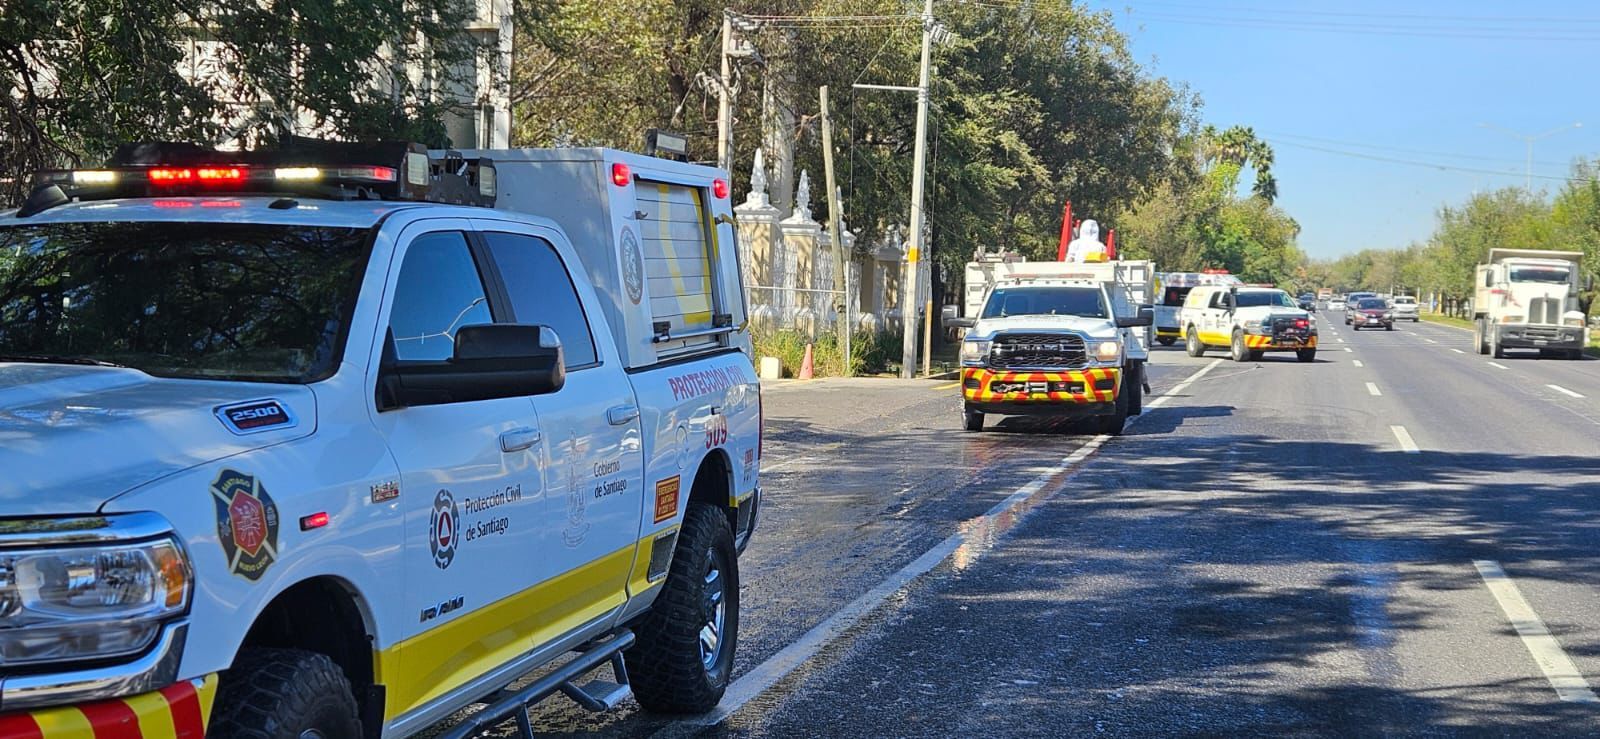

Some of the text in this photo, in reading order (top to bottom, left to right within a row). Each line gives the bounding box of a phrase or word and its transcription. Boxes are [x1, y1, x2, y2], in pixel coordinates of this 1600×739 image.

[231, 406, 279, 420] 2500
[705, 415, 727, 449] 509
[593, 460, 621, 477] Gobierno
[594, 478, 627, 498] de Santiago
[465, 484, 521, 515] Protección Civil
[466, 517, 509, 541] de Santiago
